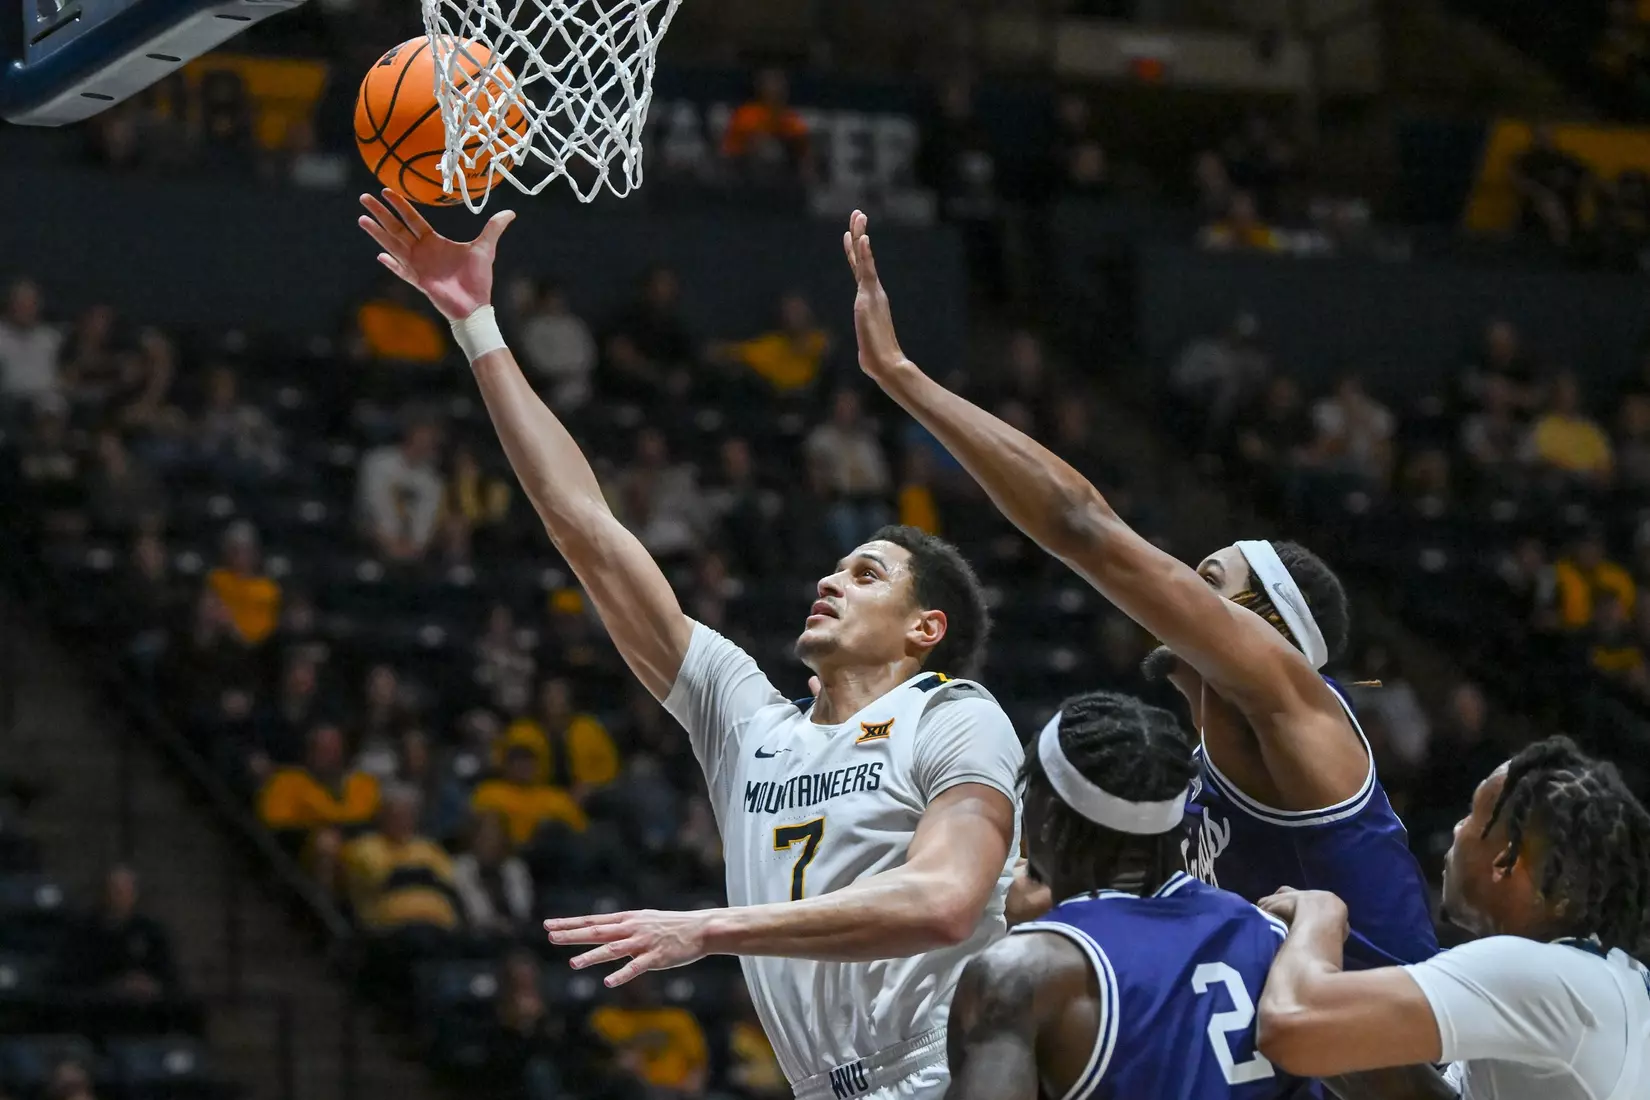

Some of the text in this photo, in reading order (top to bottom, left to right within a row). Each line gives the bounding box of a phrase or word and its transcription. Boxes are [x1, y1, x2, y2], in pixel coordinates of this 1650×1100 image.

[773, 816, 826, 901] 7
[1191, 961, 1275, 1085] 2
[829, 1060, 869, 1100] WVU
